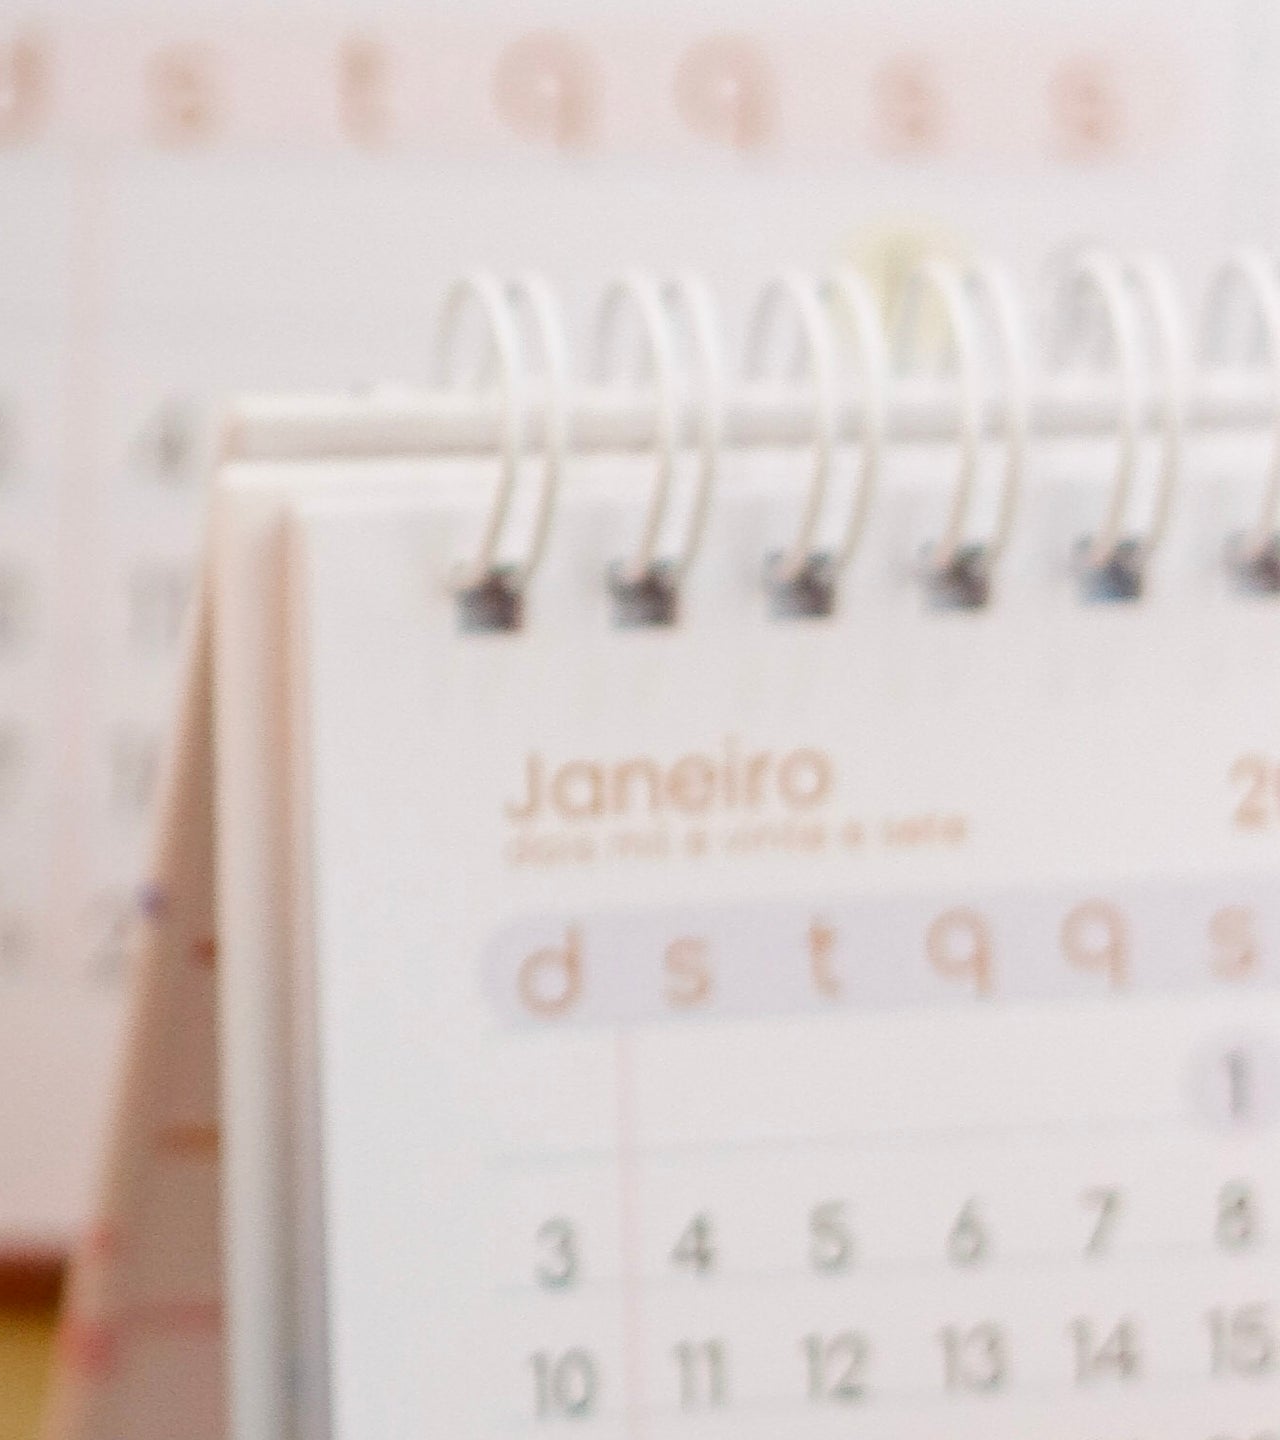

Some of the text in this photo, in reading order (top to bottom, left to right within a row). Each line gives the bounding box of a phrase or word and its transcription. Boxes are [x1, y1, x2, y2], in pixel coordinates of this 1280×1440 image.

[504, 735, 836, 822] Janeiro
[516, 897, 1261, 1019] d s t q q s
[535, 1182, 1255, 1294] 3 4 5 6 7 8
[529, 1304, 1278, 1422] 10 11 12 13 14 15
